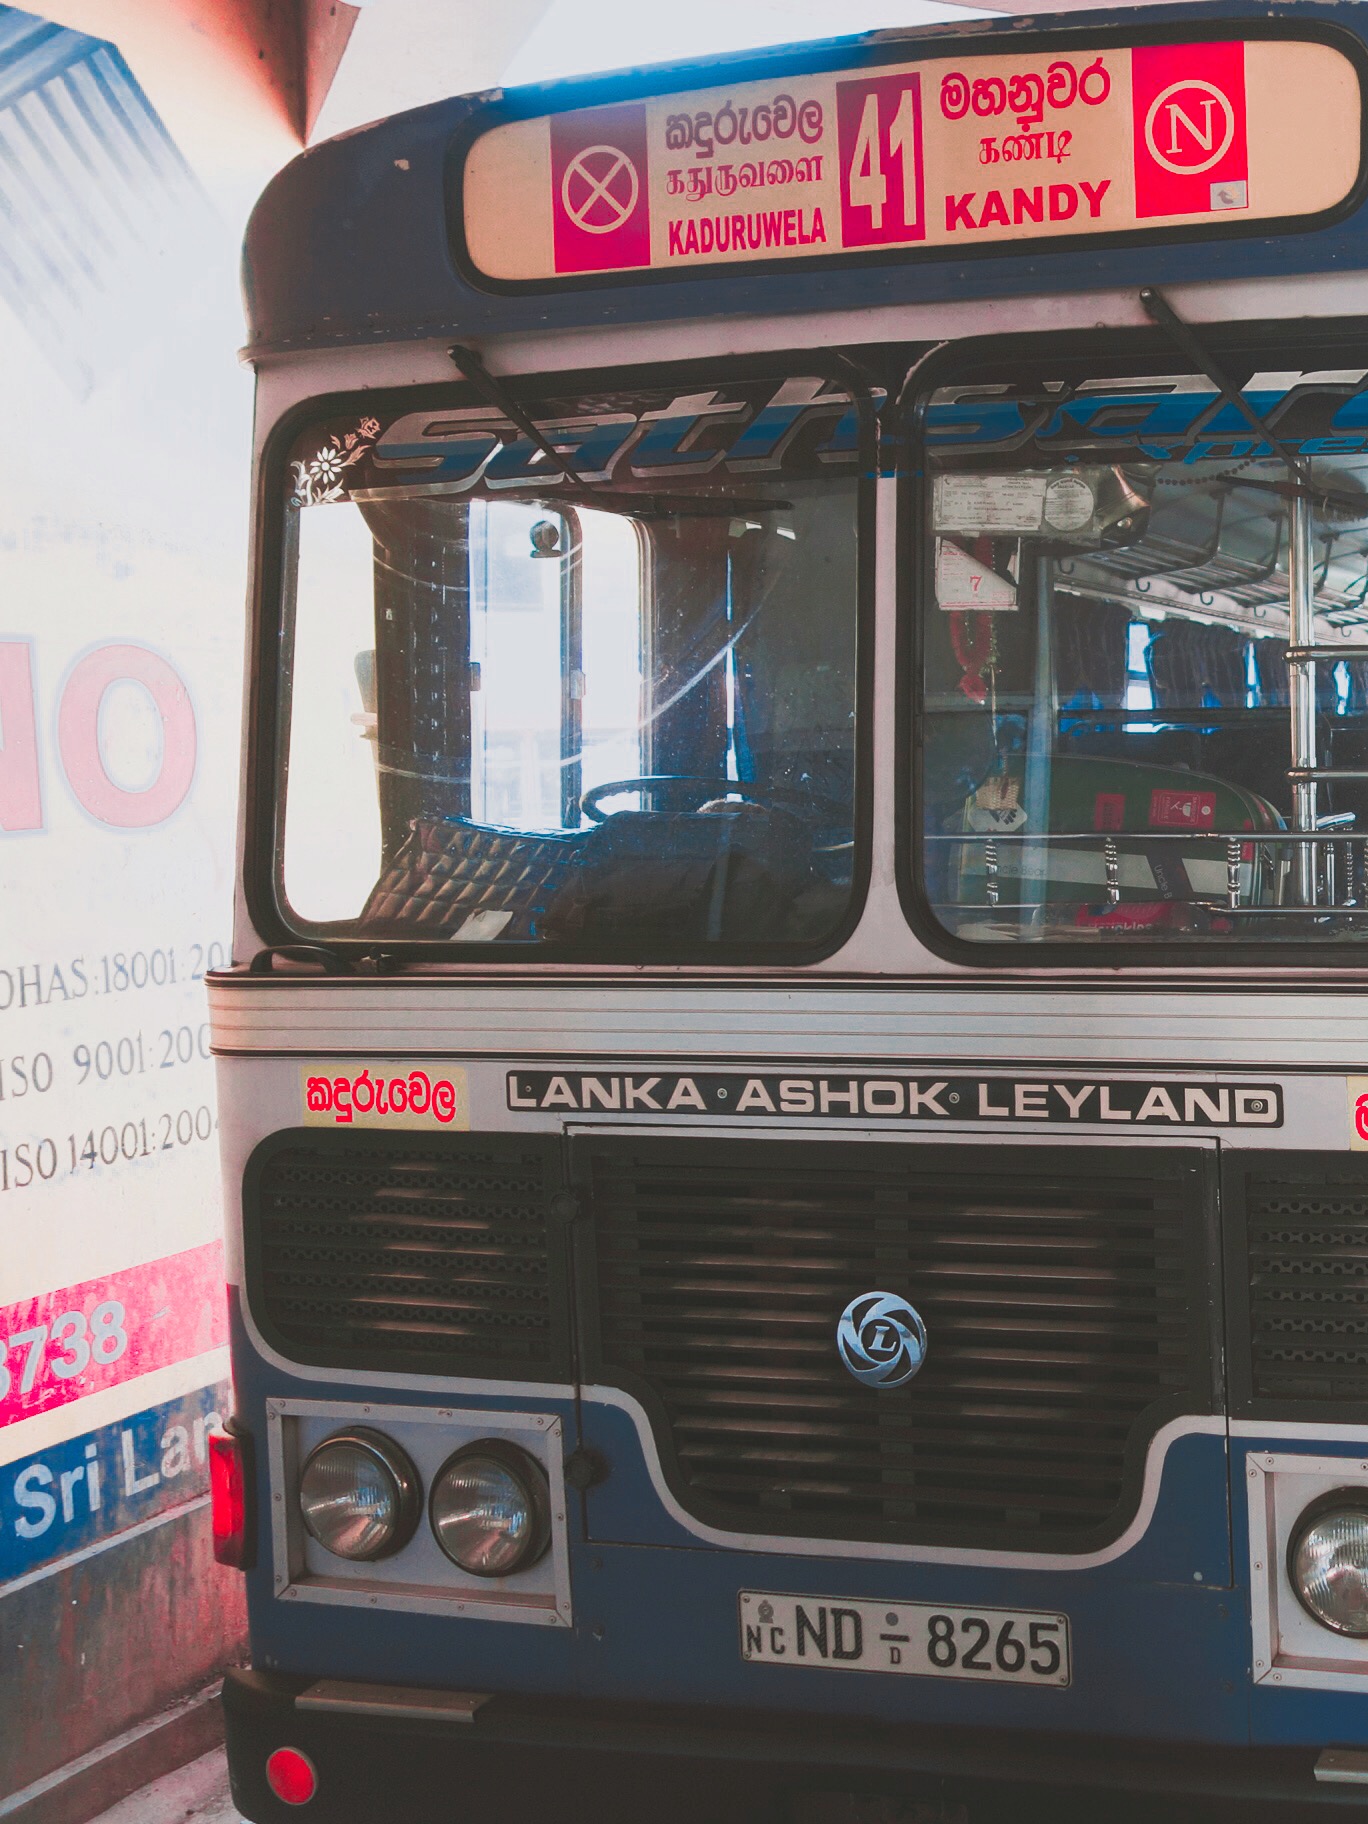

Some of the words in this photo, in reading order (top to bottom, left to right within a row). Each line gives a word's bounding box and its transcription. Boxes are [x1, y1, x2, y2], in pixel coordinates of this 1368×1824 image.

[939, 57, 1111, 125] මහනුවර
[665, 94, 824, 159] කදුරුවෙල
[978, 122, 1073, 164] கண்டி
[1165, 99, 1217, 154] N
[849, 88, 917, 230] 41
[945, 179, 1112, 231] KANDY
[668, 207, 827, 257] KADURUWELA
[969, 575, 982, 592] 7
[306, 1069, 456, 1122] කදුරුවෙල
[508, 1075, 706, 1111] LANKA
[735, 1078, 949, 1116] ASHOK
[978, 1084, 1278, 1124] LEYLAND
[1, 1138, 58, 1191] ISO
[14, 1443, 102, 1540] Sri
[746, 1625, 786, 1656] NC
[795, 1604, 863, 1661] ND
[927, 1614, 1061, 1676] 8265
